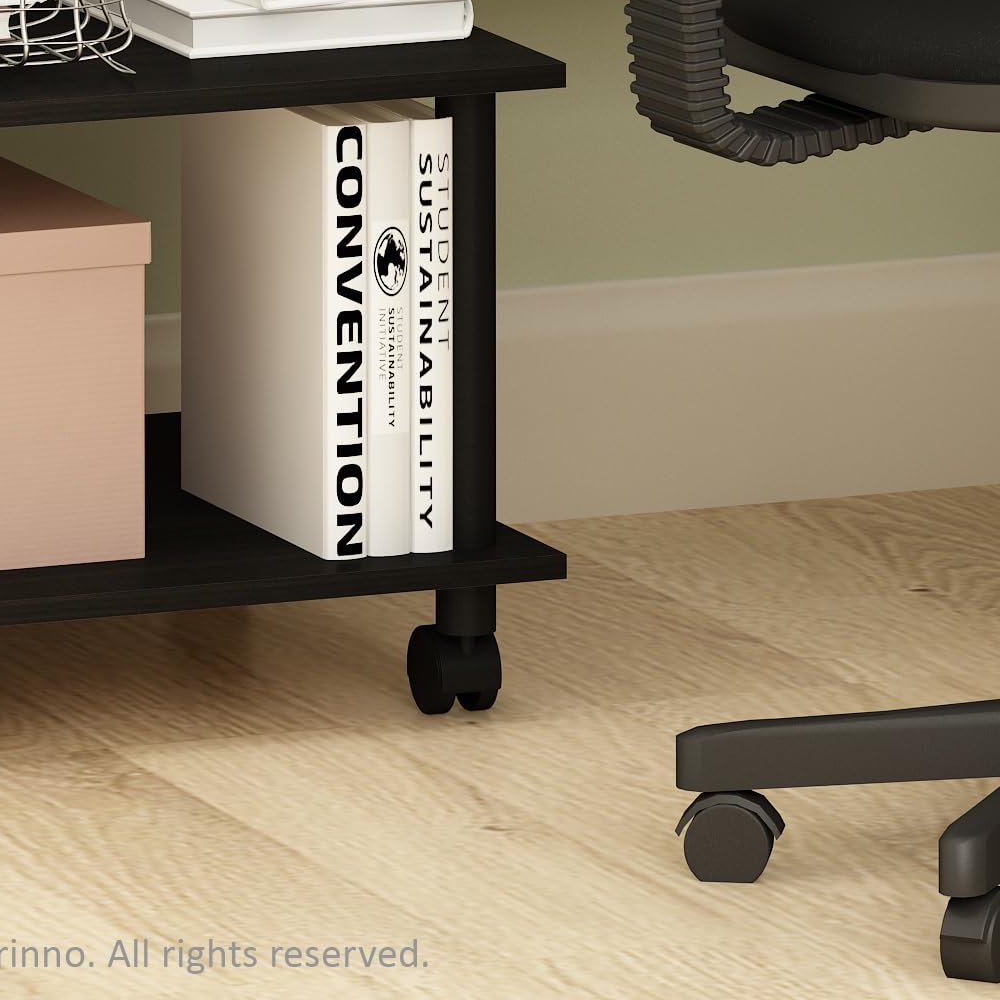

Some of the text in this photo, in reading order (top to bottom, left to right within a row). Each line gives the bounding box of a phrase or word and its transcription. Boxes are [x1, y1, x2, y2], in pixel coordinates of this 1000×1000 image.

[336, 125, 363, 557] CONVENTION
[379, 307, 387, 381] INITIATIVE
[419, 153, 433, 529] SUSTAINABILITY
[437, 153, 450, 351] STUDENT
